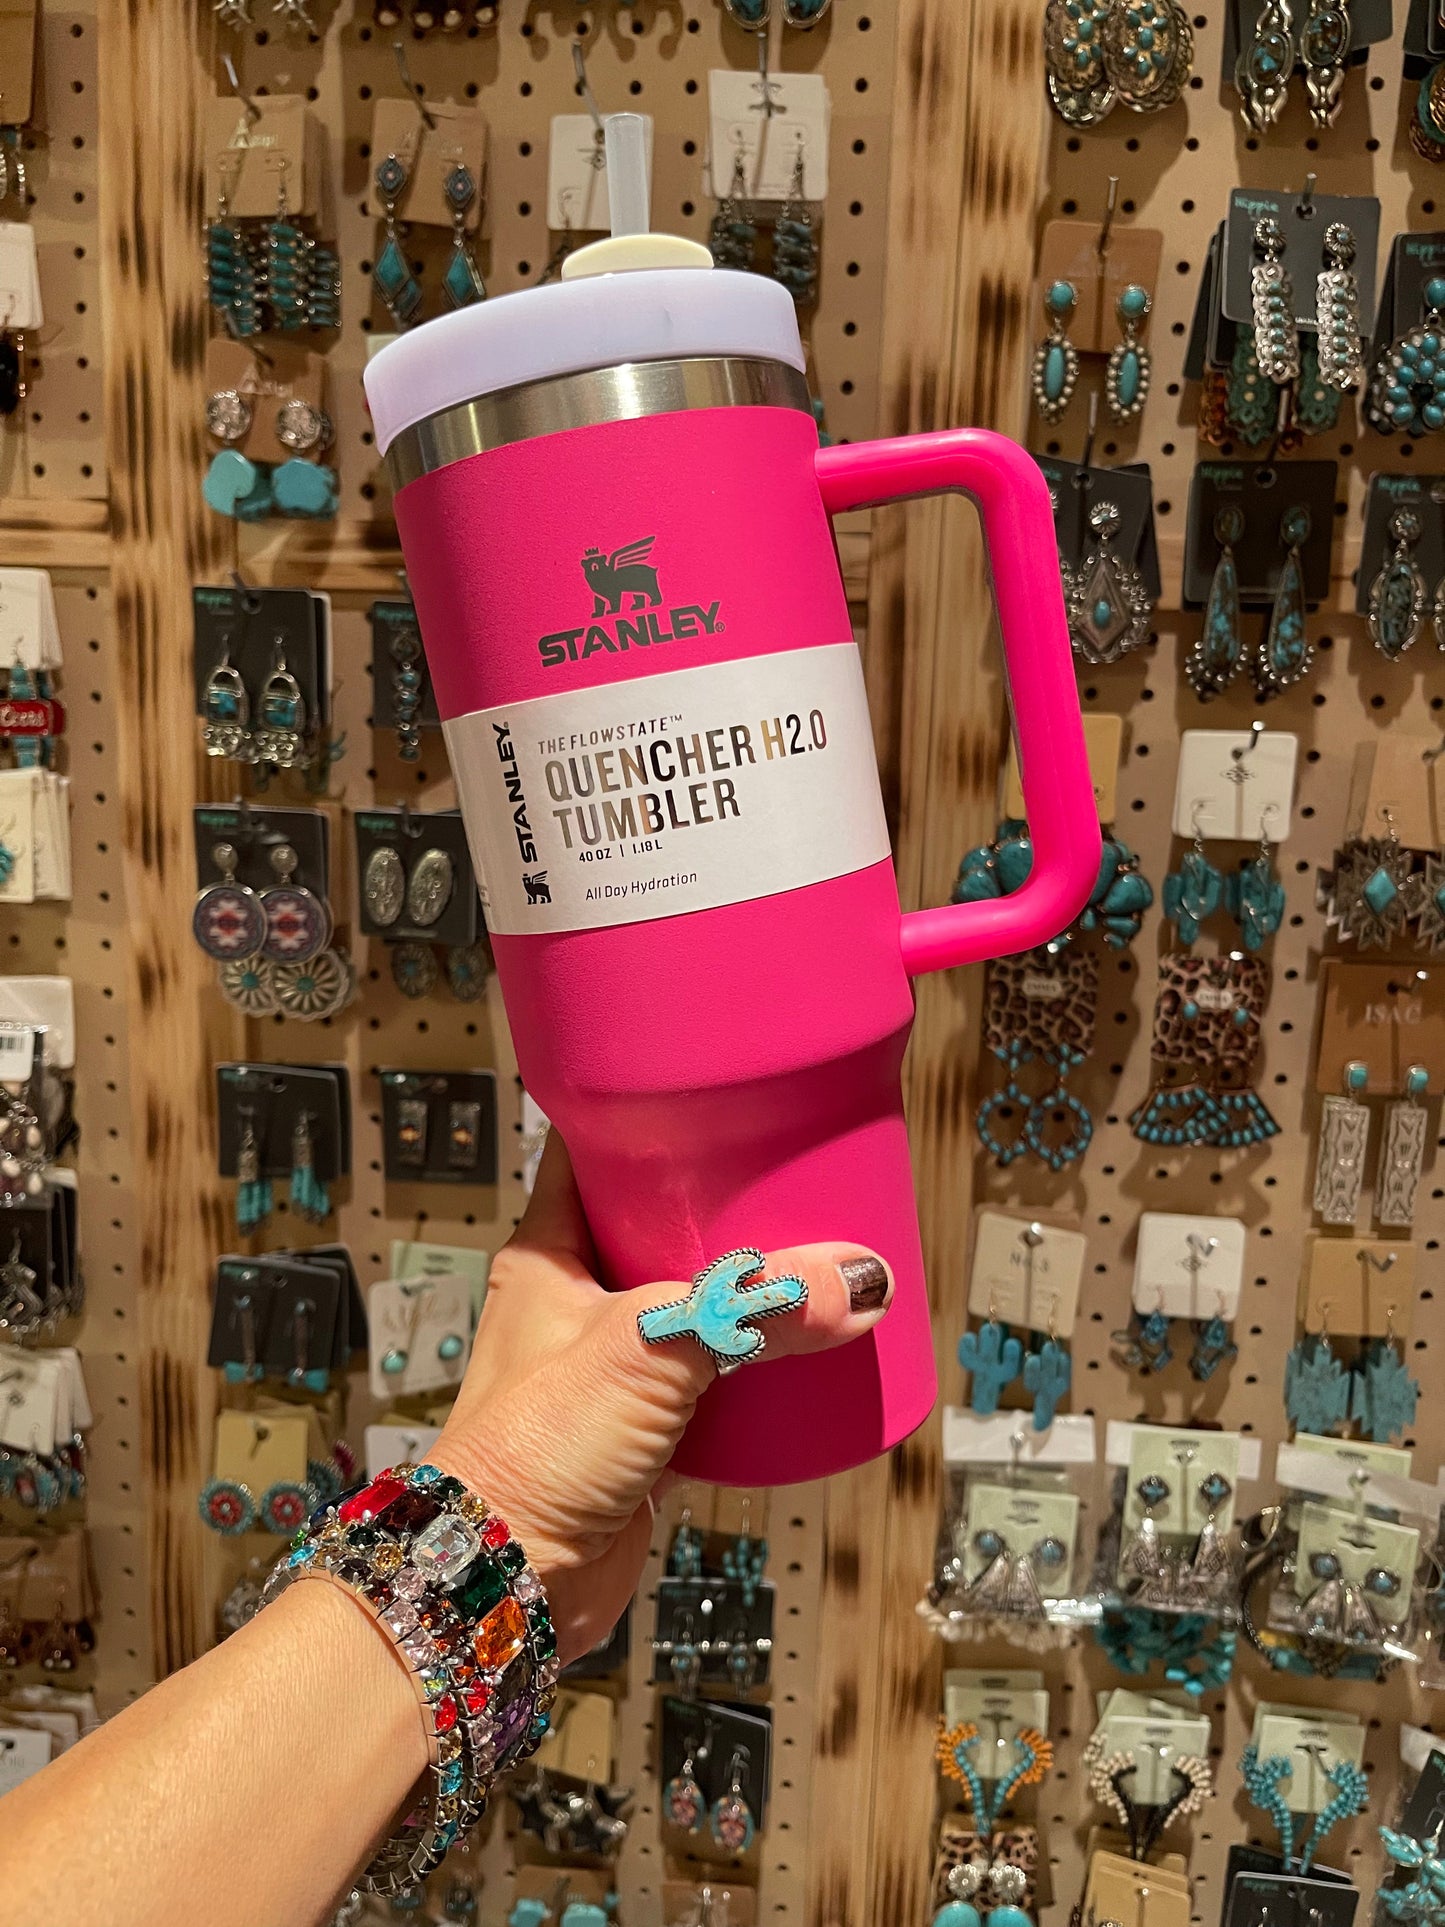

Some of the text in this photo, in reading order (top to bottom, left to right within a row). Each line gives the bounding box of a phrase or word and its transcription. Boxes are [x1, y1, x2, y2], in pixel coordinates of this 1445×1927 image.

[538, 735, 566, 755] THE
[544, 709, 827, 802] QUENCHER H2.0
[552, 777, 741, 849] TUMBLER
[579, 850, 594, 863] 40
[595, 847, 612, 861] OZ
[632, 840, 653, 855] 1.18
[654, 839, 663, 850] L
[585, 872, 697, 901] All Day Hydration
